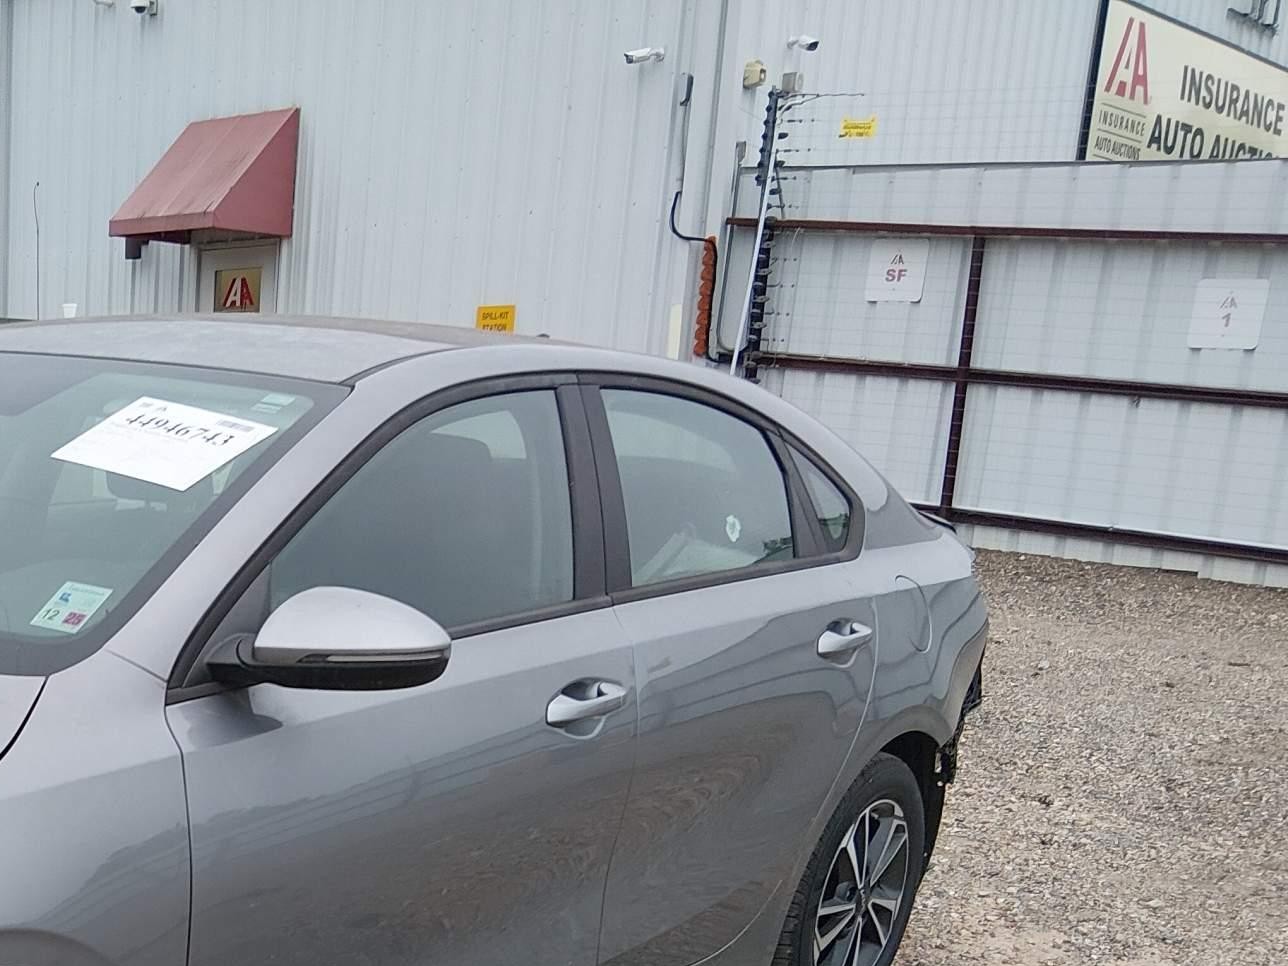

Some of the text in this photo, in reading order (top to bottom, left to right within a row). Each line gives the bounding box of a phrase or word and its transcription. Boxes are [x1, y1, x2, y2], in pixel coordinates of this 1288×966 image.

[1180, 64, 1286, 137] INSURANCE
[1098, 109, 1146, 137] INSURANCE
[1094, 135, 1112, 153] AUTO
[1146, 114, 1205, 160] AUTO
[885, 268, 908, 282] SF
[1221, 313, 1232, 328] 1
[125, 414, 235, 446] 44946743
[42, 608, 60, 620] 12
